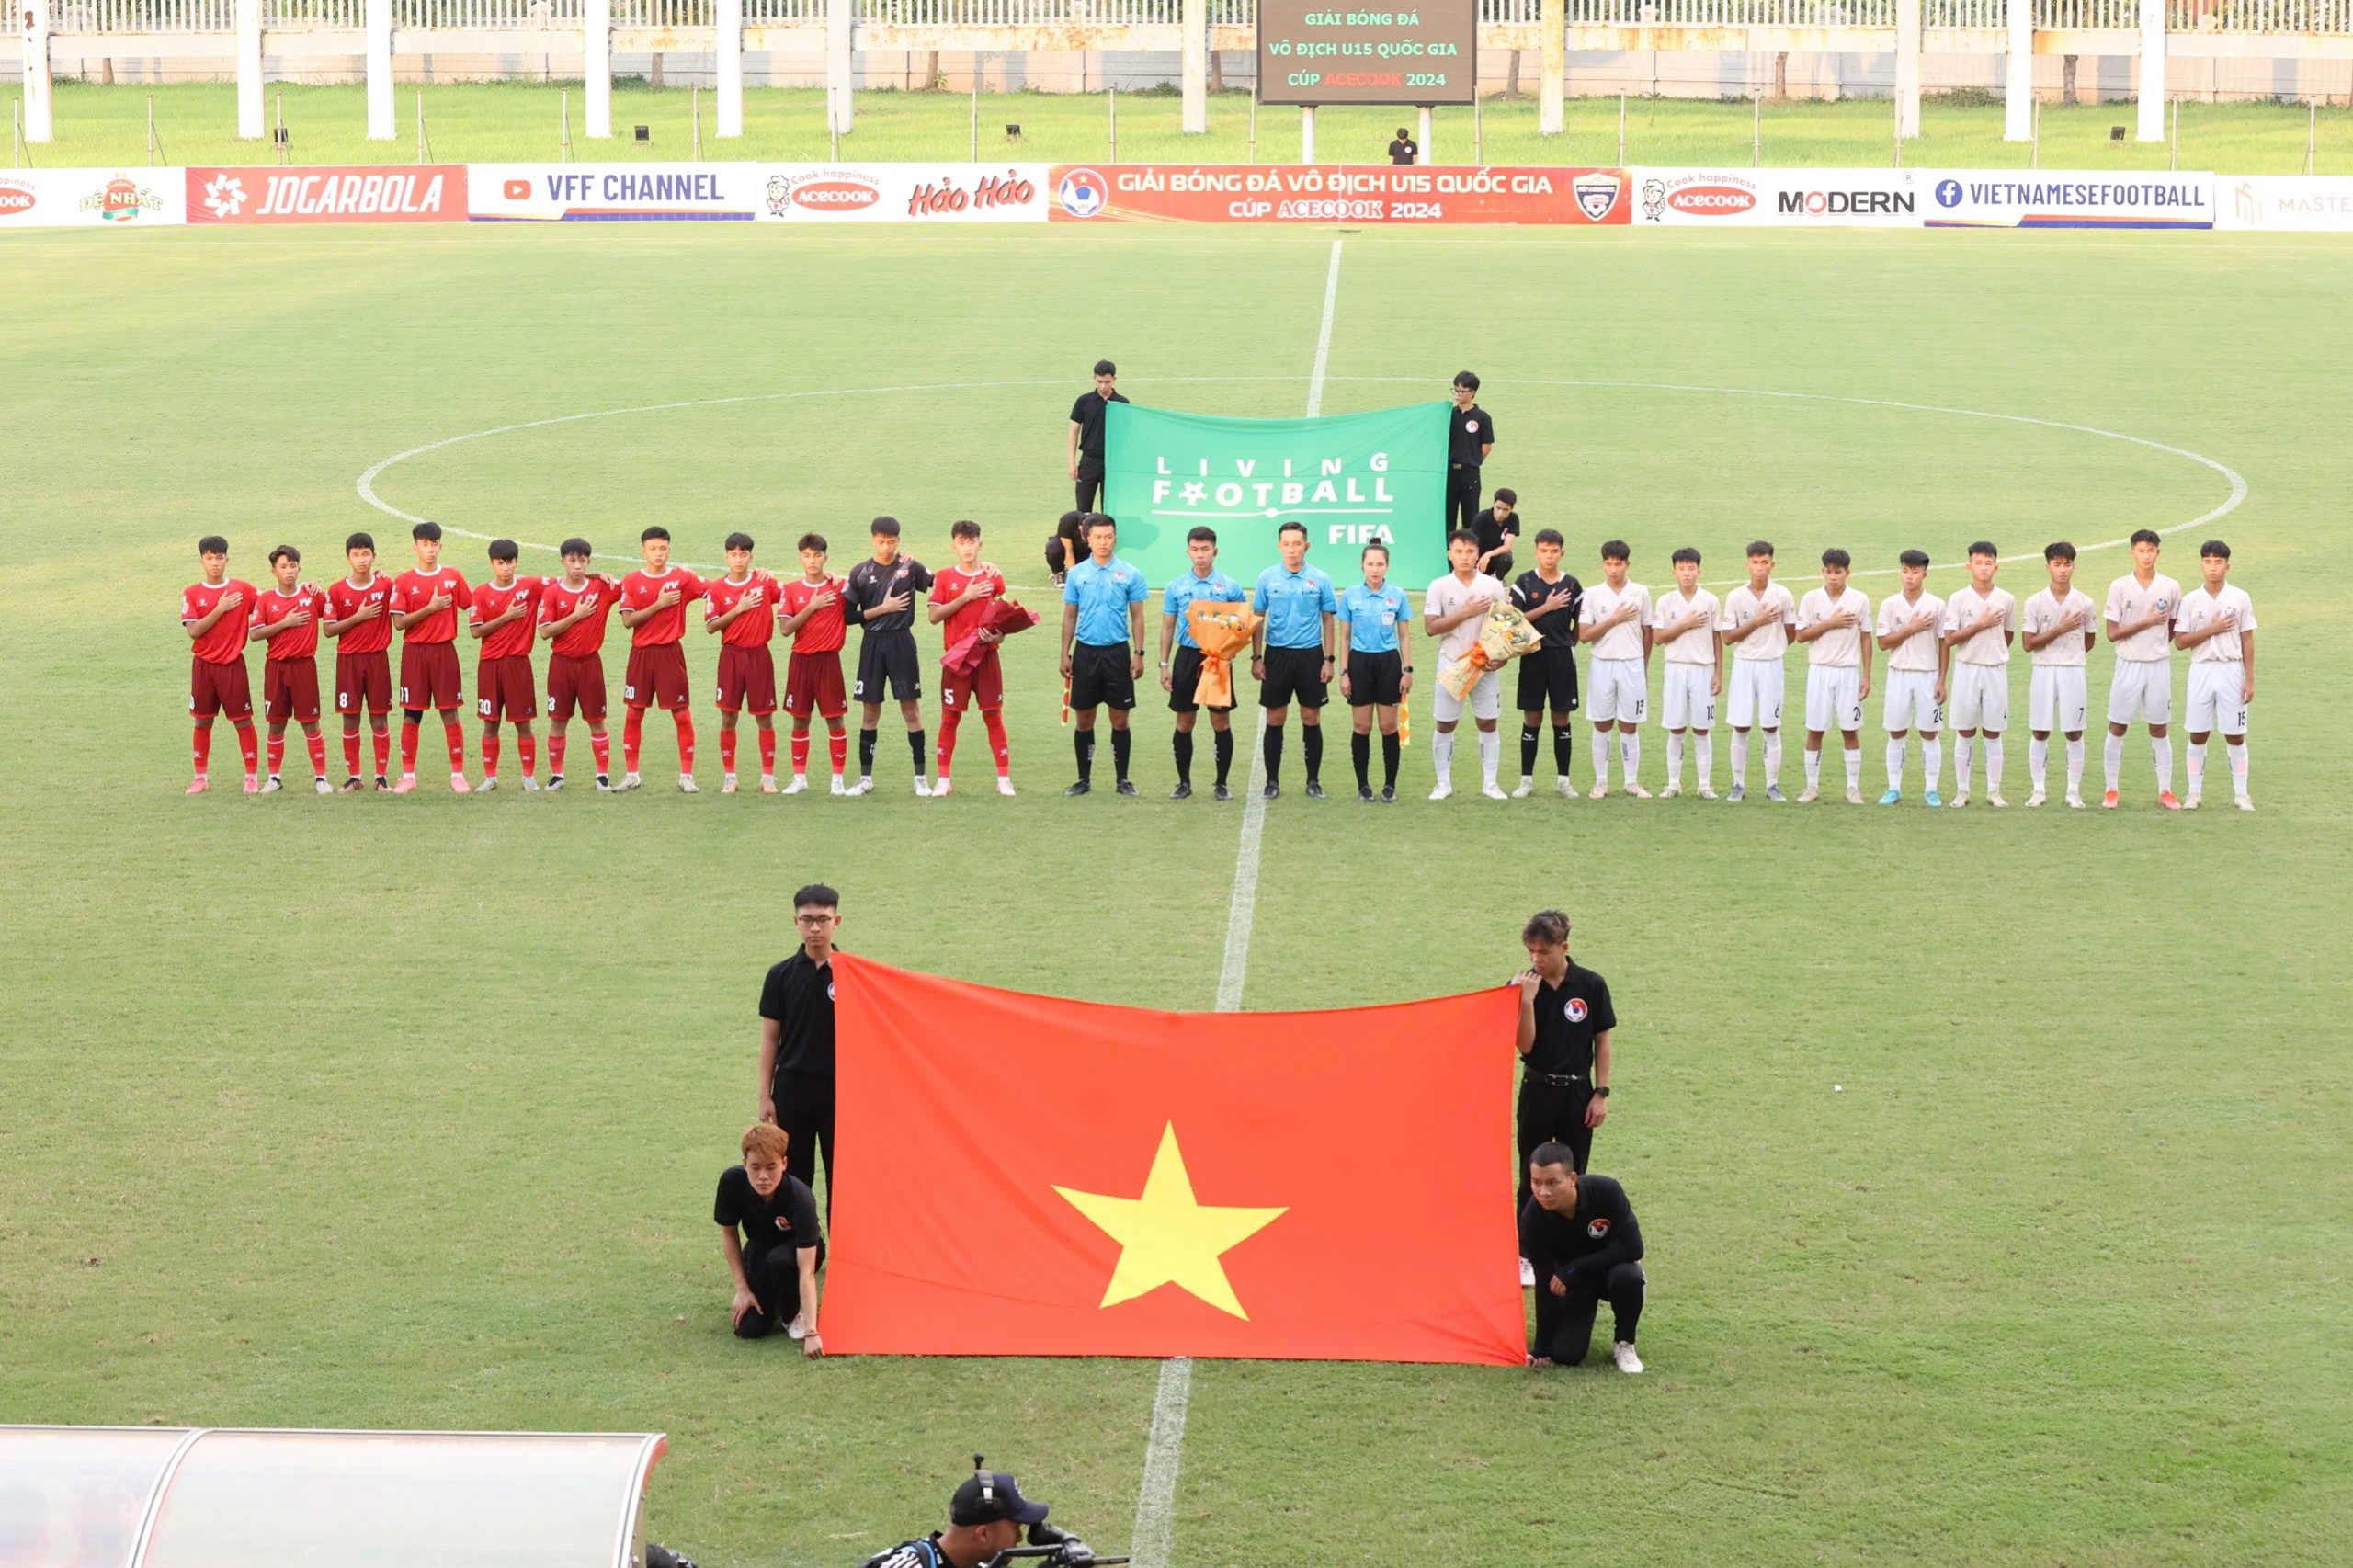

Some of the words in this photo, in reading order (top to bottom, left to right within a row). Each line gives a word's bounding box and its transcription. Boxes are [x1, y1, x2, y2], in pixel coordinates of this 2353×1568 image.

[1304, 8, 1342, 25] GIẢI
[1347, 8, 1392, 25] BÓNG
[1397, 8, 1419, 25] ĐÁ
[1268, 39, 1292, 56] VÔ
[1295, 42, 1337, 59] ĐỊCH
[1341, 42, 1373, 56] U15
[1427, 42, 1458, 56] GIA
[1287, 68, 1321, 86] CÚP
[1324, 73, 1402, 87] ACECOOK
[1405, 73, 1447, 86] 2024
[791, 170, 820, 185] Cook
[823, 169, 880, 186] happiness
[1118, 168, 1165, 192] GIẢI
[1170, 168, 1242, 192] BÓNG
[1245, 168, 1283, 192] ĐÁ
[1286, 168, 1323, 192] VÔ
[1327, 174, 1386, 195] ĐỊCH
[1392, 175, 1432, 192] U15
[1436, 166, 1506, 193] QUỐC
[1511, 176, 1553, 194] GIA
[1666, 174, 1696, 188] Cook
[1699, 172, 1756, 190] happiness
[256, 175, 444, 215] JOGARBOLA
[546, 175, 595, 201] VFF
[603, 174, 725, 201] CHANNEL
[908, 176, 970, 217] Hảo
[974, 168, 1036, 209] Hảo
[1970, 183, 2205, 207] VIETNAMESEFOOTBALL
[109, 188, 164, 210] NHẤT
[1228, 197, 1272, 218] CÚP
[1277, 199, 1384, 219] ACECOOK
[1390, 202, 1443, 219] 2024
[1779, 190, 1915, 214] MODERN
[1156, 452, 1389, 478] LIVING
[1328, 524, 1395, 544] FIFA
[339, 692, 348, 708] 8
[547, 694, 556, 712] 8
[945, 688, 954, 705] 5
[265, 700, 272, 716] 7
[478, 699, 492, 715] 30
[1636, 699, 1644, 715] 13
[1707, 704, 1715, 721] 10
[1774, 703, 1780, 719] 6
[2079, 707, 2085, 722] 7
[2238, 711, 2246, 727] 15
